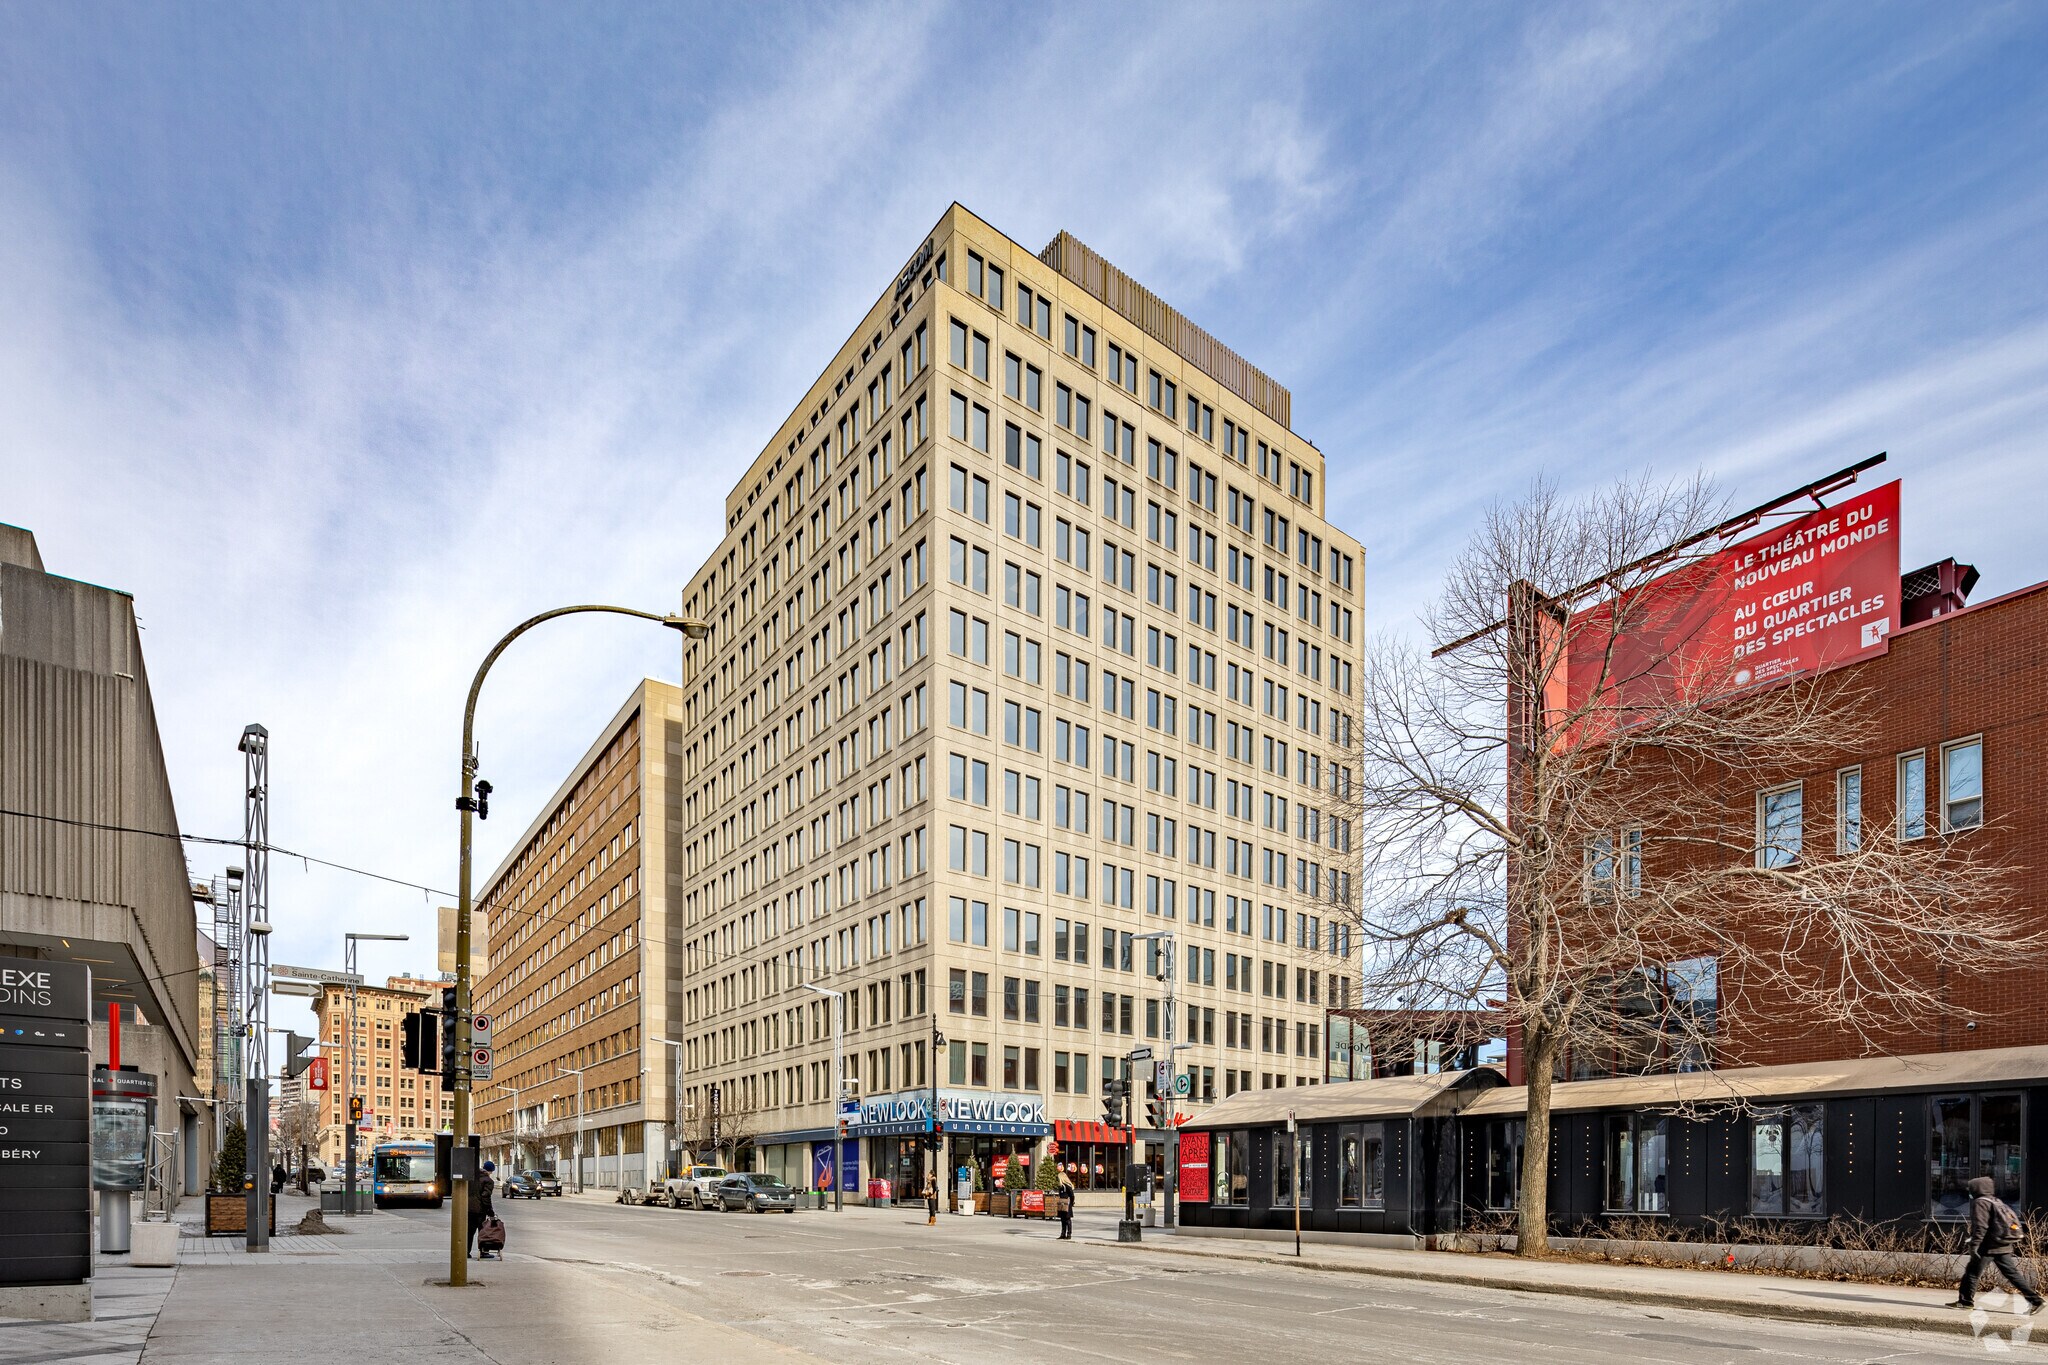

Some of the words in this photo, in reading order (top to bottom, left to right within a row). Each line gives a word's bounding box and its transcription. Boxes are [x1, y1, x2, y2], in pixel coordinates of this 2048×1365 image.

[1734, 553, 1754, 572] LE
[1758, 518, 1840, 561] THÉÂTRE
[1847, 504, 1873, 527] DU
[1734, 548, 1815, 591] NOUVEAU
[1820, 518, 1889, 557] MONDE
[1733, 602, 1756, 622] AU
[1762, 581, 1814, 611] CŒUR
[1734, 620, 1757, 640] DU
[1763, 586, 1852, 629] QUARTIER
[1733, 636, 1767, 659] DES
[1772, 594, 1885, 646] SPECTACLES
[0, 969, 51, 989] EXE
[291, 970, 360, 985] Sainte-Catherine
[117, 1078, 147, 1086] QUARTIER
[35, 1104, 54, 1113] ER
[2, 1149, 41, 1159] BÉRY
